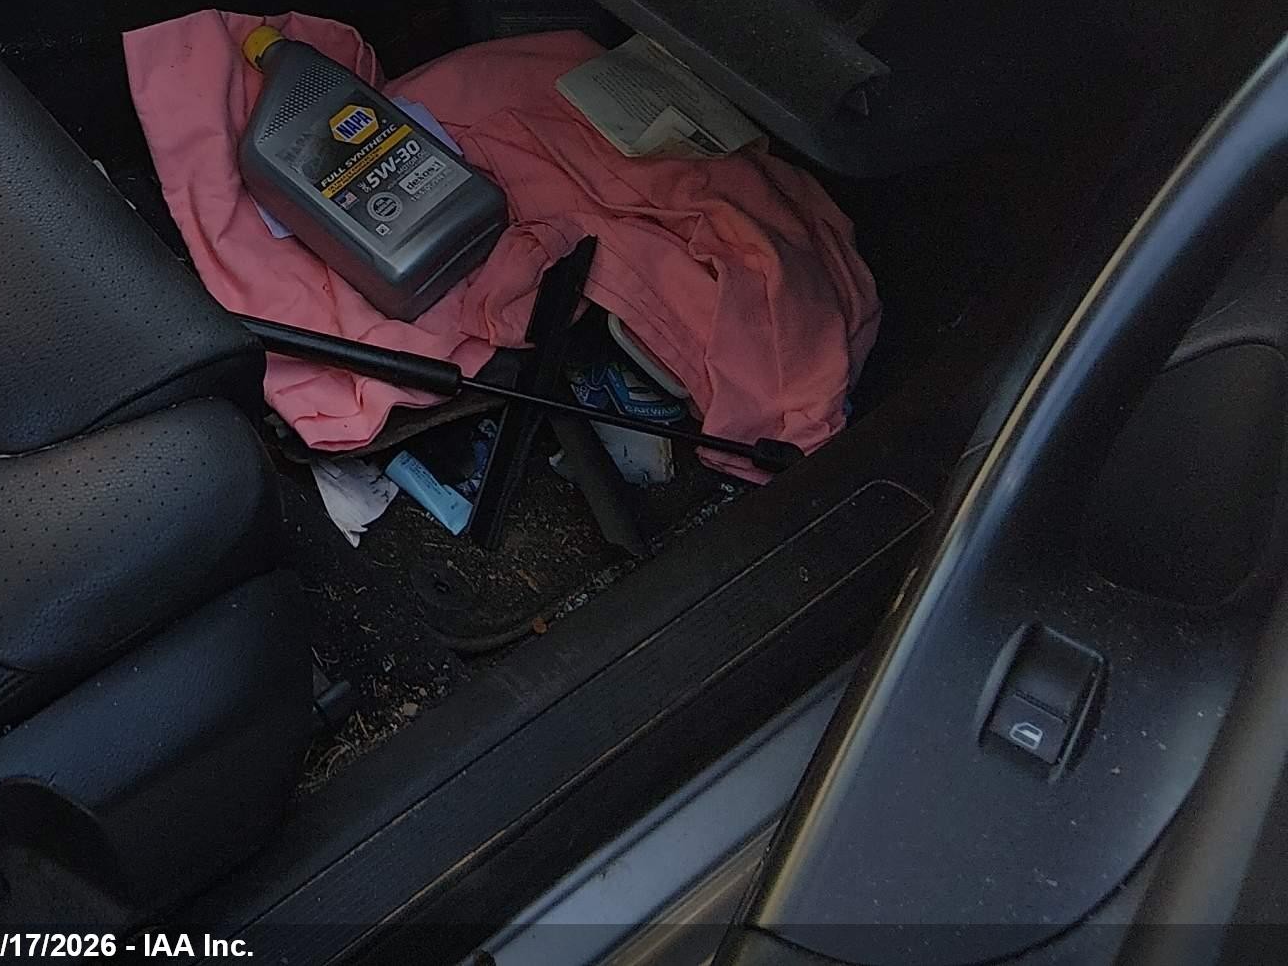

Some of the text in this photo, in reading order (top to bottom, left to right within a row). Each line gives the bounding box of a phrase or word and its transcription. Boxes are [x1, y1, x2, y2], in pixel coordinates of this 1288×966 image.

[335, 110, 373, 139] NAPA
[320, 167, 347, 188] FULL
[346, 123, 398, 168] SYNTHETIC
[364, 138, 422, 188] 5W-30
